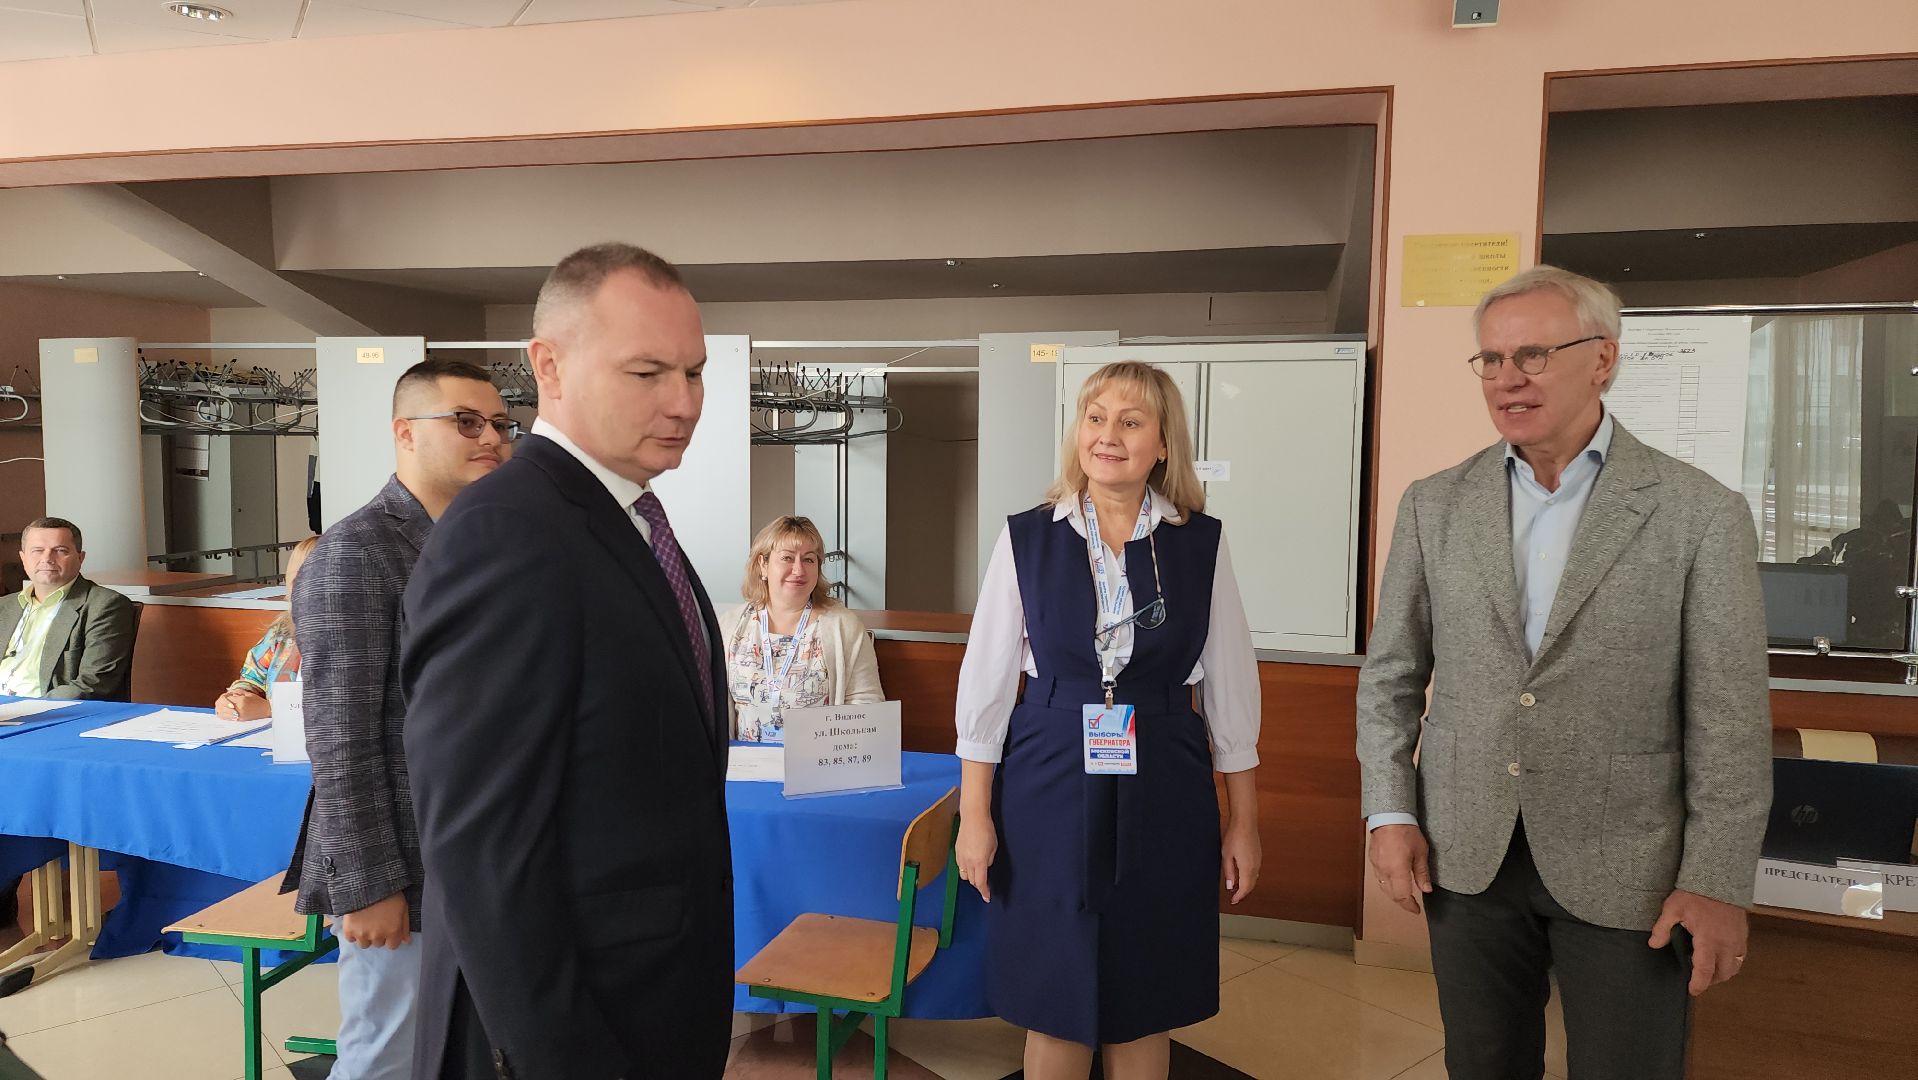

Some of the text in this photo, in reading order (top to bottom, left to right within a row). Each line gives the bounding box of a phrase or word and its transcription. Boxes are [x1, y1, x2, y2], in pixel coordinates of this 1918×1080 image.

[835, 713, 867, 721] Видное
[814, 726, 877, 739] ул. Школьная
[861, 754, 872, 763] 89
